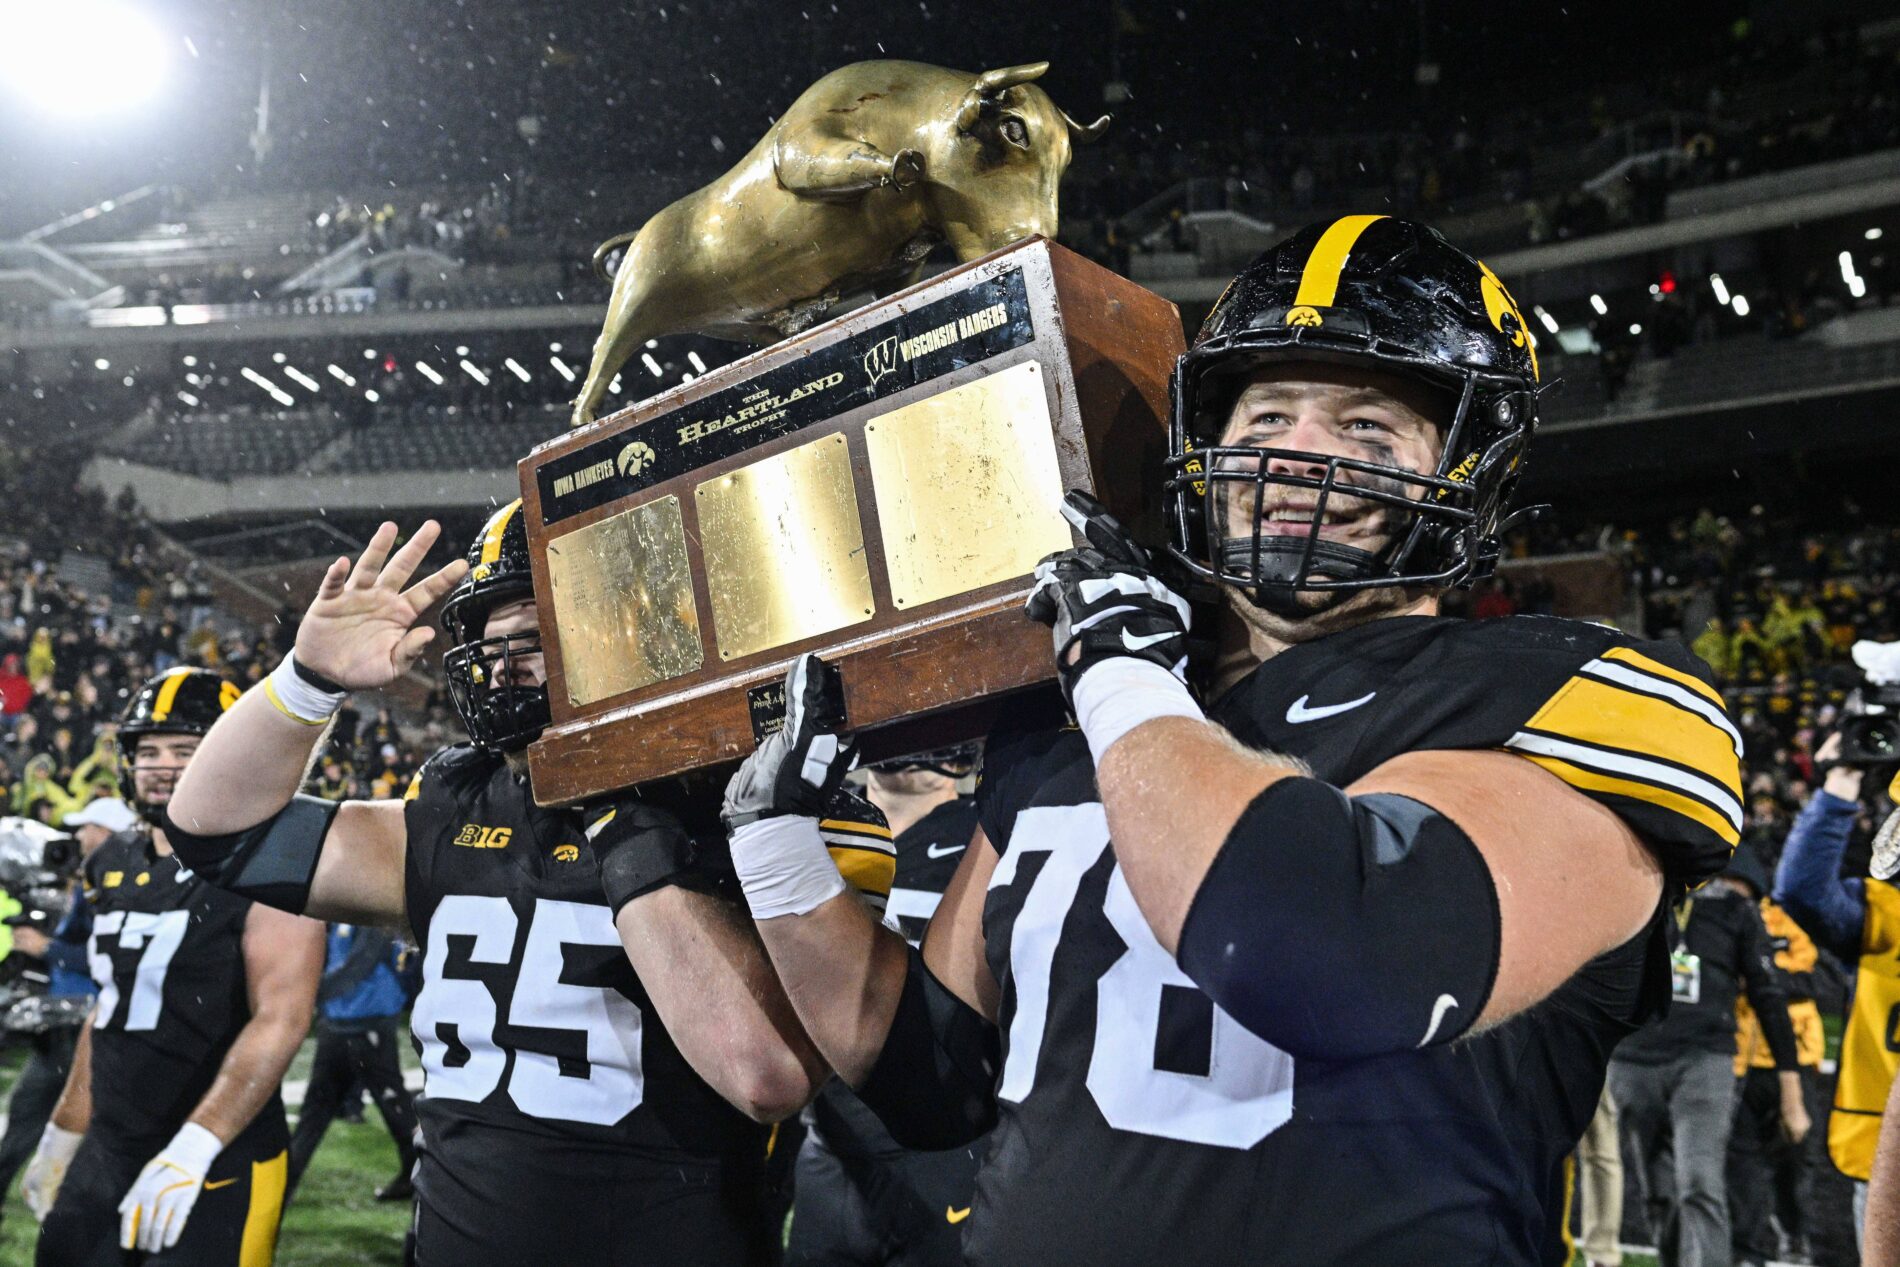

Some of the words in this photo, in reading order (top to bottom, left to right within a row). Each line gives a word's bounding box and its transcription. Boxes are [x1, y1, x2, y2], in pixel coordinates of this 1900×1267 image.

[899, 321, 959, 362] WISCONSIN
[958, 302, 1008, 340] BADGERS
[676, 371, 844, 446] HEARTLAND
[733, 409, 788, 435] TROPHY
[742, 389, 770, 404] THE
[553, 474, 575, 498] IOWA
[574, 458, 615, 490] HAWKEYES
[86, 909, 191, 1032] 57
[987, 801, 1296, 1150] 78
[410, 894, 645, 1126] 65
